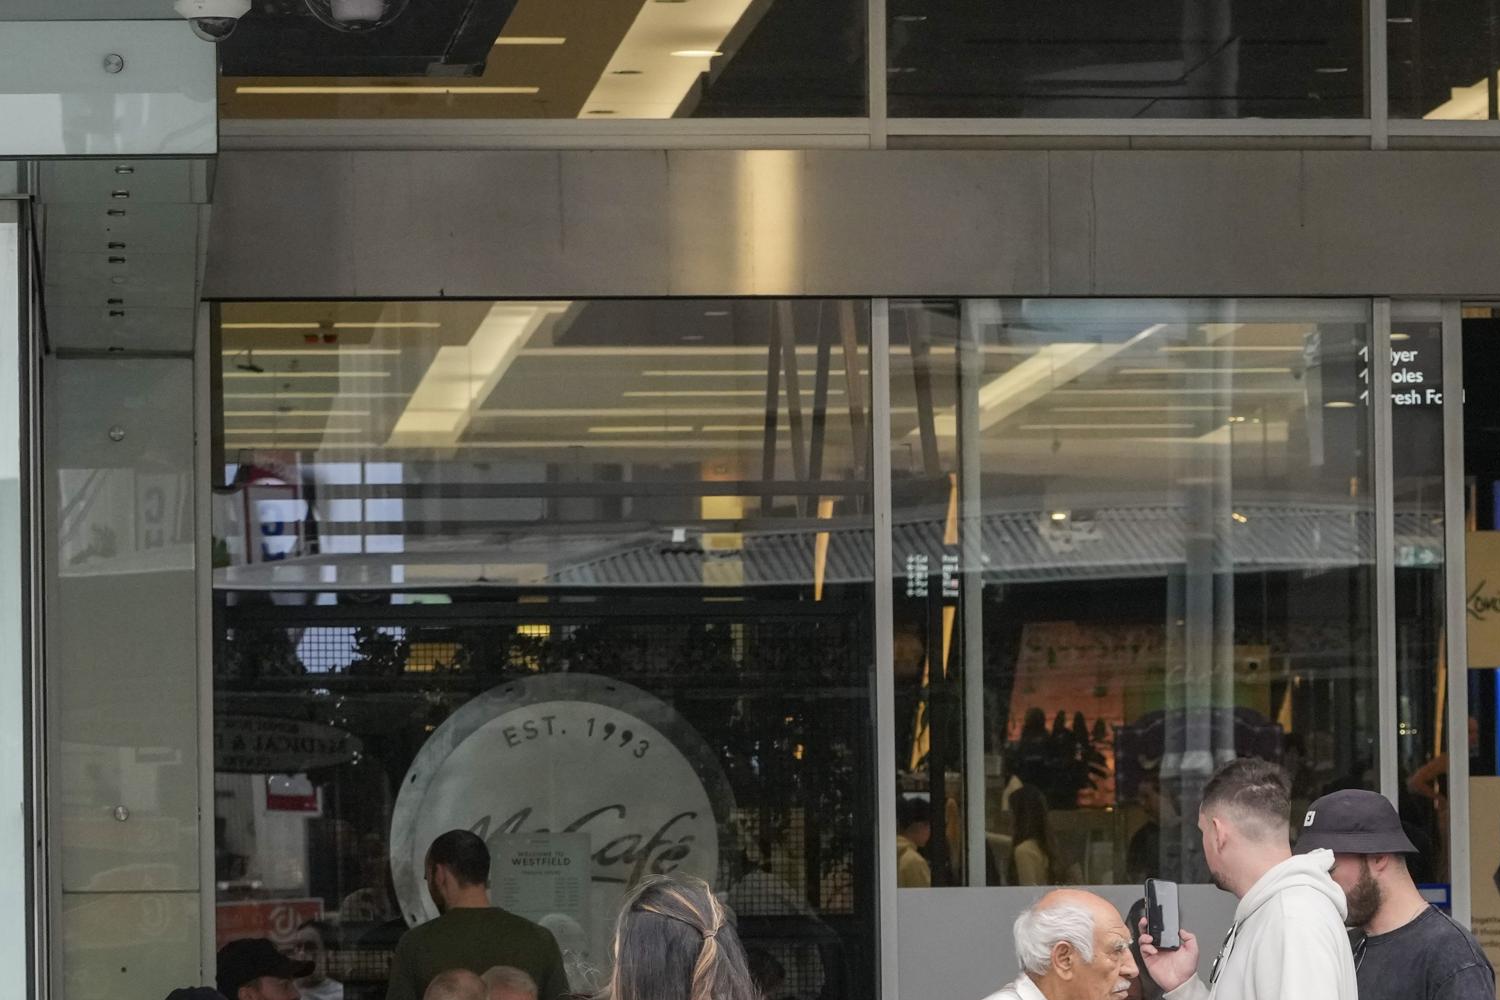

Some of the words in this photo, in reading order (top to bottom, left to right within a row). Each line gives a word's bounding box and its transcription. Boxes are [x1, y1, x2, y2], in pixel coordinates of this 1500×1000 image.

[1390, 348, 1418, 366] yer
[1391, 368, 1424, 384] oles
[502, 715, 567, 749] EST.
[512, 857, 571, 866] WESTFIELD
